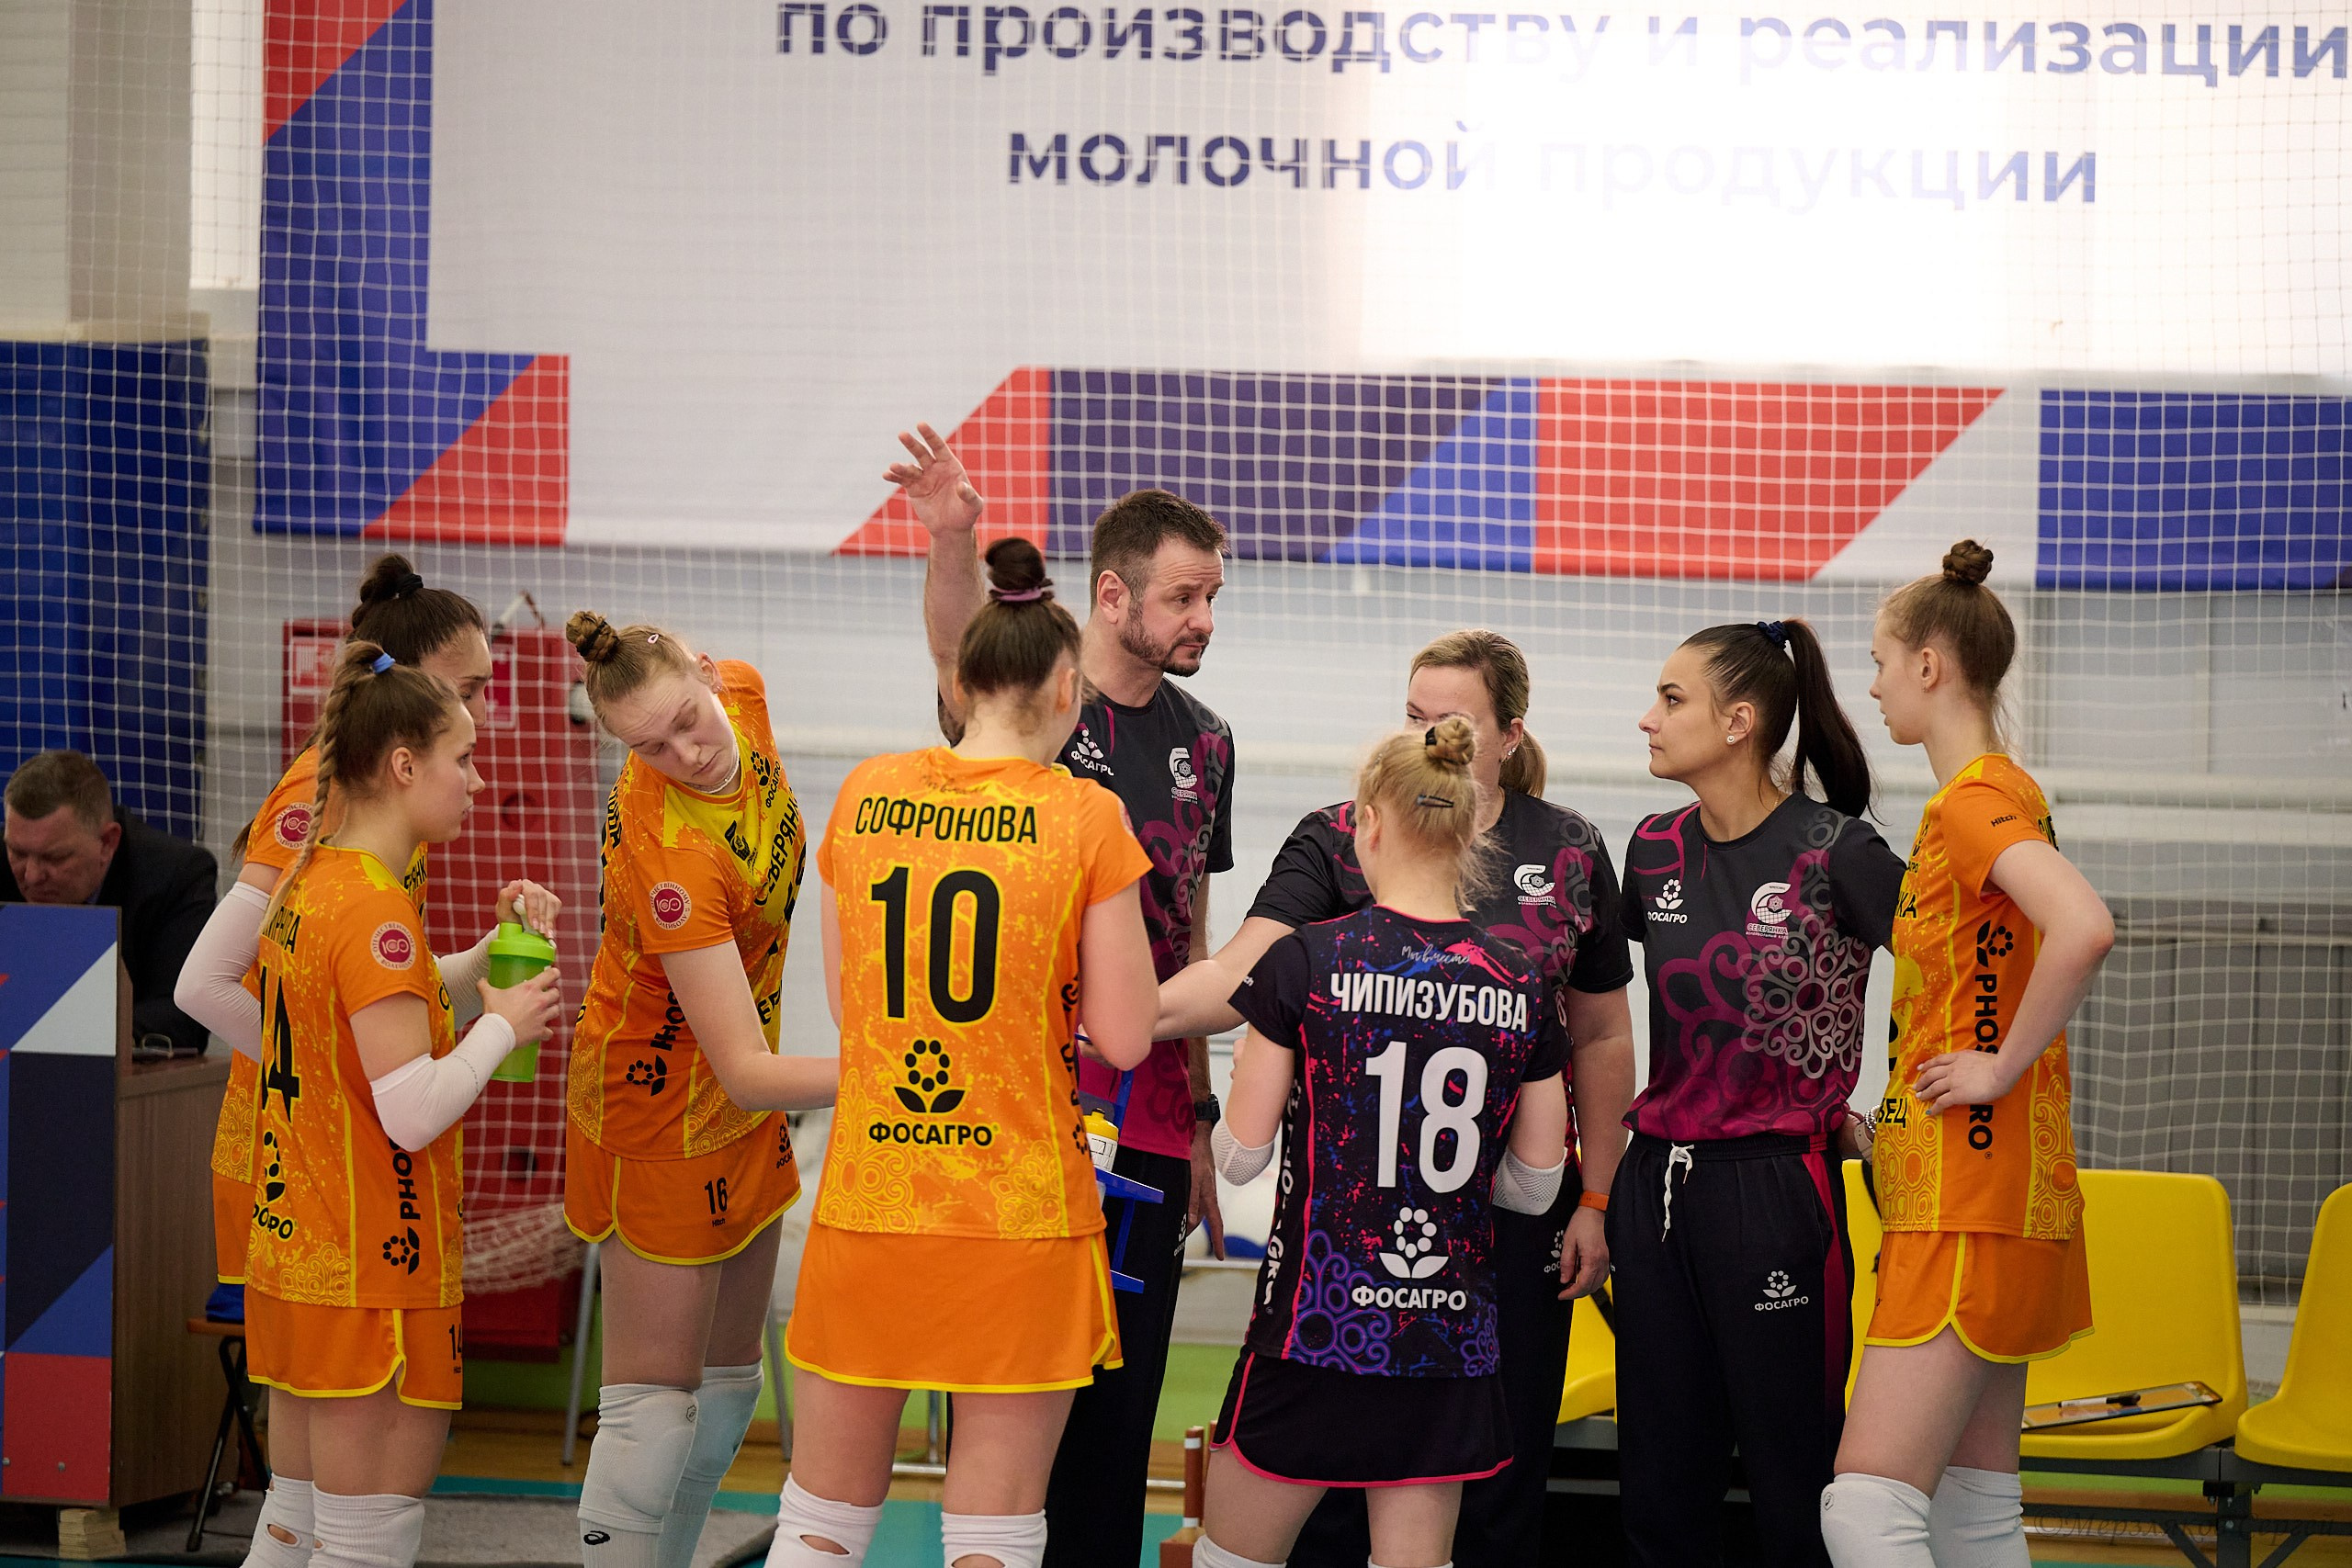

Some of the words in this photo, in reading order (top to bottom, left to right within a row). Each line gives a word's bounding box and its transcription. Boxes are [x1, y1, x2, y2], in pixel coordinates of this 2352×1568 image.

[776, 3, 889, 56] по
[920, 5, 1611, 84] производству
[1647, 15, 1699, 67] и
[1738, 16, 2349, 88] реализации
[1008, 119, 1497, 191] молочной
[1540, 141, 2098, 216] продукции
[764, 761, 782, 808] ФОСАГРО
[854, 795, 1038, 845] СОФРОНОВА
[1990, 814, 2018, 828] Hitch
[870, 865, 1001, 1023] 10
[1330, 972, 1528, 1032] ЧИПИЗУБОВА
[868, 1122, 993, 1146] ФОСАГРО
[1364, 1040, 1489, 1194] 18
[704, 1177, 729, 1215] 16
[1351, 1286, 1468, 1311] ФОСАГРО
[1754, 1294, 1810, 1312] ФОСАГРО
